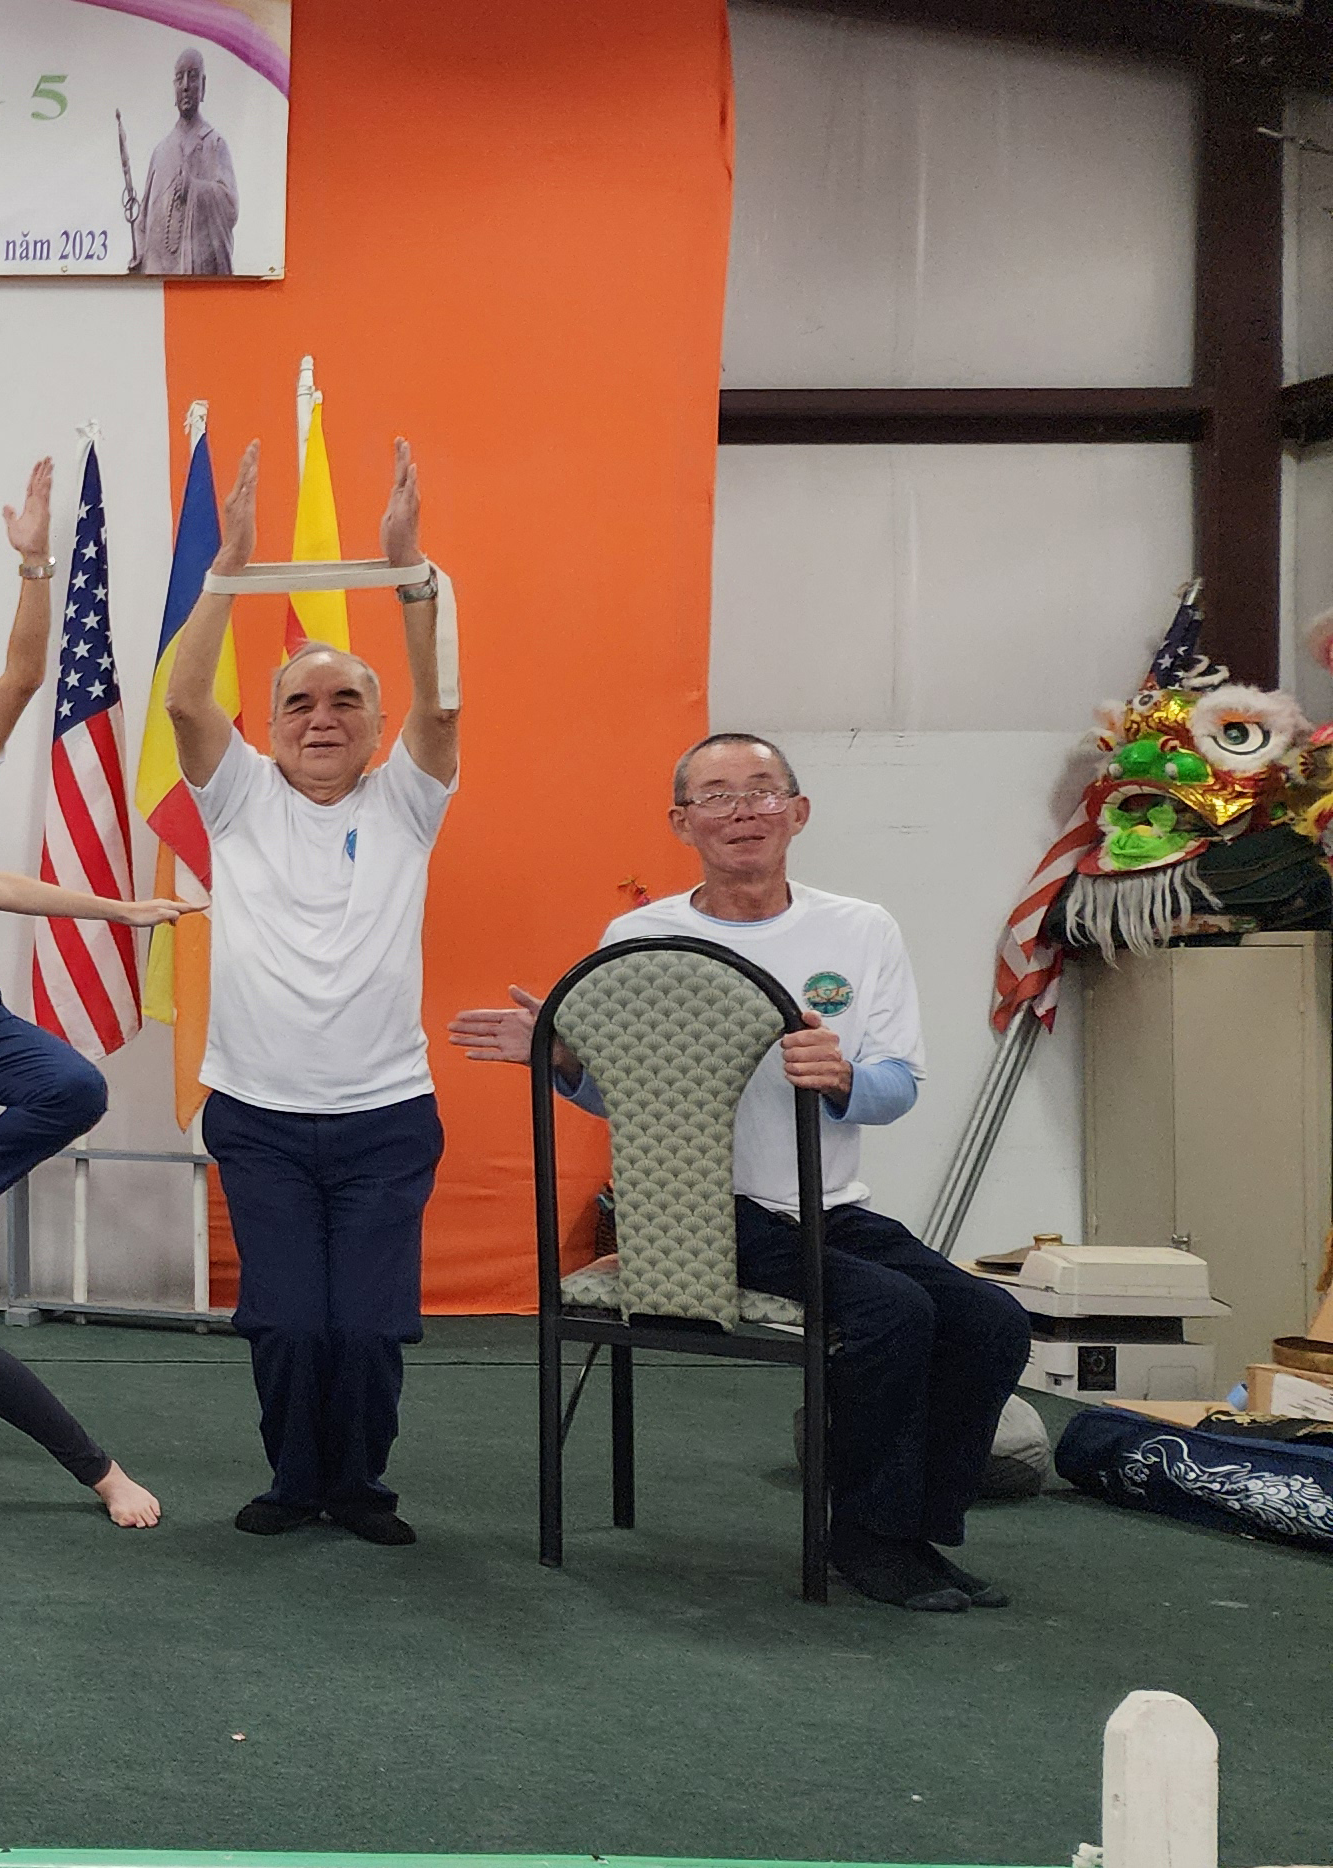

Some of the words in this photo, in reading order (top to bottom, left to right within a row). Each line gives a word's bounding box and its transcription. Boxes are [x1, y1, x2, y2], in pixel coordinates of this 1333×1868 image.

[31, 74, 69, 121] 5
[4, 231, 52, 262] năm
[59, 230, 110, 262] 2023
